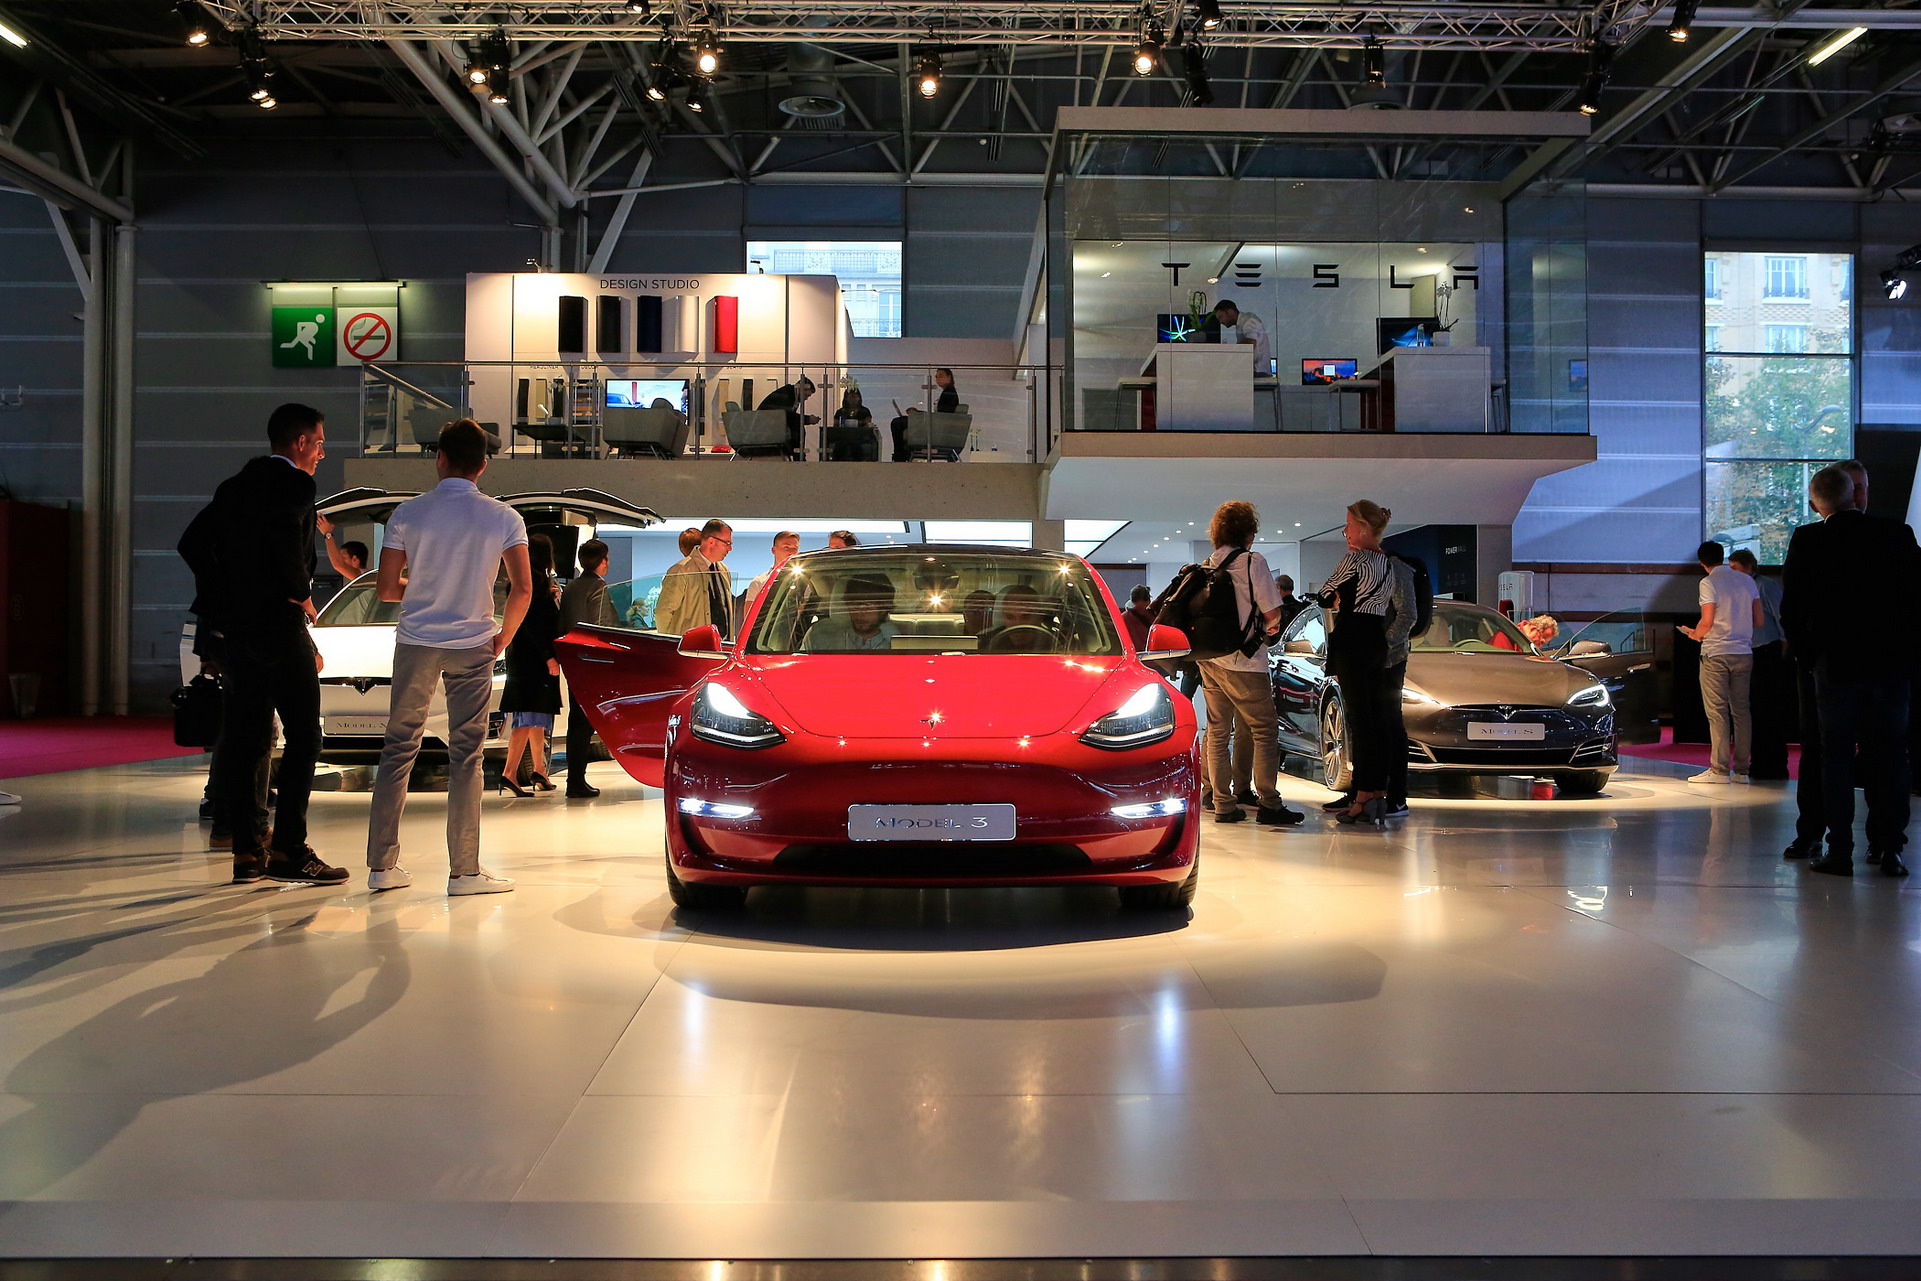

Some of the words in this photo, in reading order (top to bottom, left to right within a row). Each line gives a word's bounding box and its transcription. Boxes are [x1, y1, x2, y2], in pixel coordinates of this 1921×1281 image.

[1161, 262, 1479, 290] TESLA
[600, 279, 648, 289] DESIGN
[652, 279, 700, 289] STUDIO
[875, 817, 962, 828] MODEL
[971, 816, 988, 828] 3
